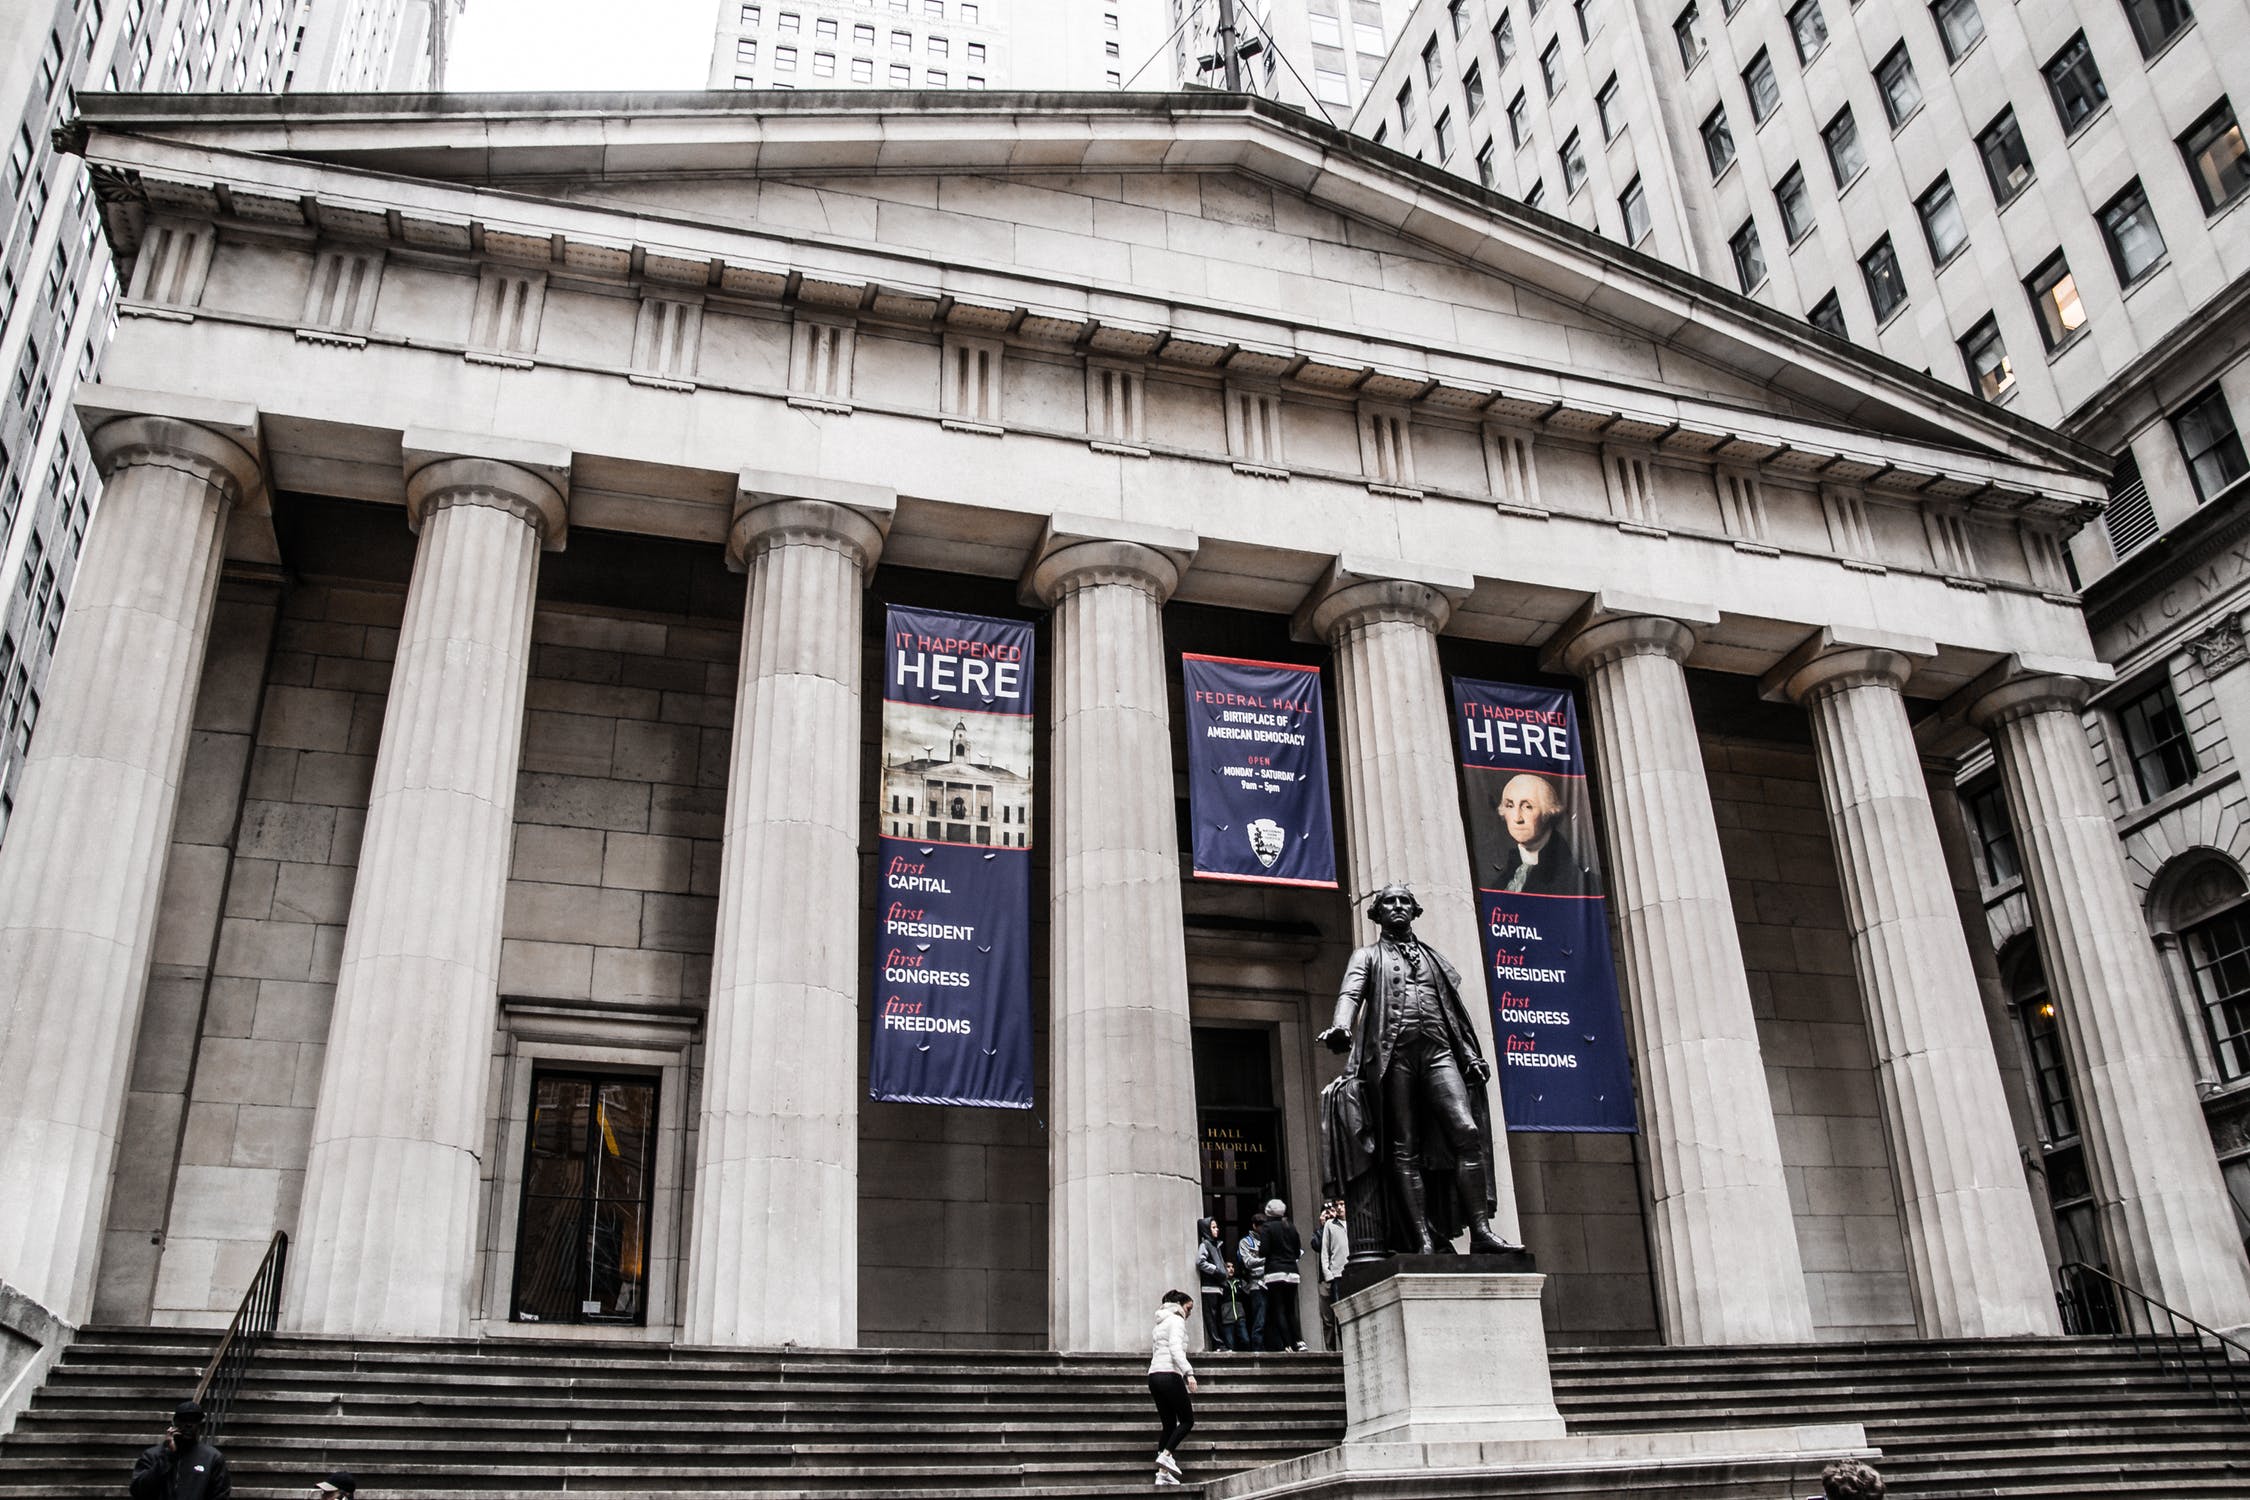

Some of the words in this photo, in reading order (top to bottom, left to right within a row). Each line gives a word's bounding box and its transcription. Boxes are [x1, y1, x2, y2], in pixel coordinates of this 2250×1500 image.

[895, 632, 912, 649] IT
[918, 635, 1022, 662] HAPPENED
[896, 650, 1020, 699] HERE
[1195, 690, 1266, 709] FEDERAL
[1273, 698, 1312, 714] HALL
[1223, 710, 1275, 726] BIRTHPLACE
[1277, 715, 1289, 727] OF
[1463, 702, 1478, 718] IT
[1482, 704, 1567, 727] HAPPENED
[1207, 726, 1253, 741] AMERICAN
[1254, 729, 1306, 746] DEMOCRACY
[1467, 718, 1571, 761] HERE
[1248, 755, 1271, 766] OPEN
[1223, 766, 1254, 778] MONDAY
[1260, 769, 1295, 782] SATURDAY
[1240, 780, 1257, 791] 9am
[1264, 782, 1281, 793] 5pm
[886, 855, 926, 877] first
[888, 874, 951, 894] CAPITAL
[884, 901, 925, 923] first
[1489, 906, 1520, 927] first
[887, 920, 974, 941] PRESIDENT
[1491, 923, 1542, 941] CAPITAL
[883, 948, 924, 971] first
[1494, 948, 1525, 969] first
[885, 967, 970, 987] CONGRESS
[1496, 965, 1566, 983] PRESIDENT
[881, 995, 923, 1018] first
[1499, 991, 1530, 1012] first
[885, 1015, 971, 1035] FREEDOMS
[1502, 1008, 1570, 1025] CONGRESS
[1504, 1034, 1536, 1055] first
[1507, 1051, 1577, 1068] FREEDOMS
[1208, 1127, 1244, 1139] HALL
